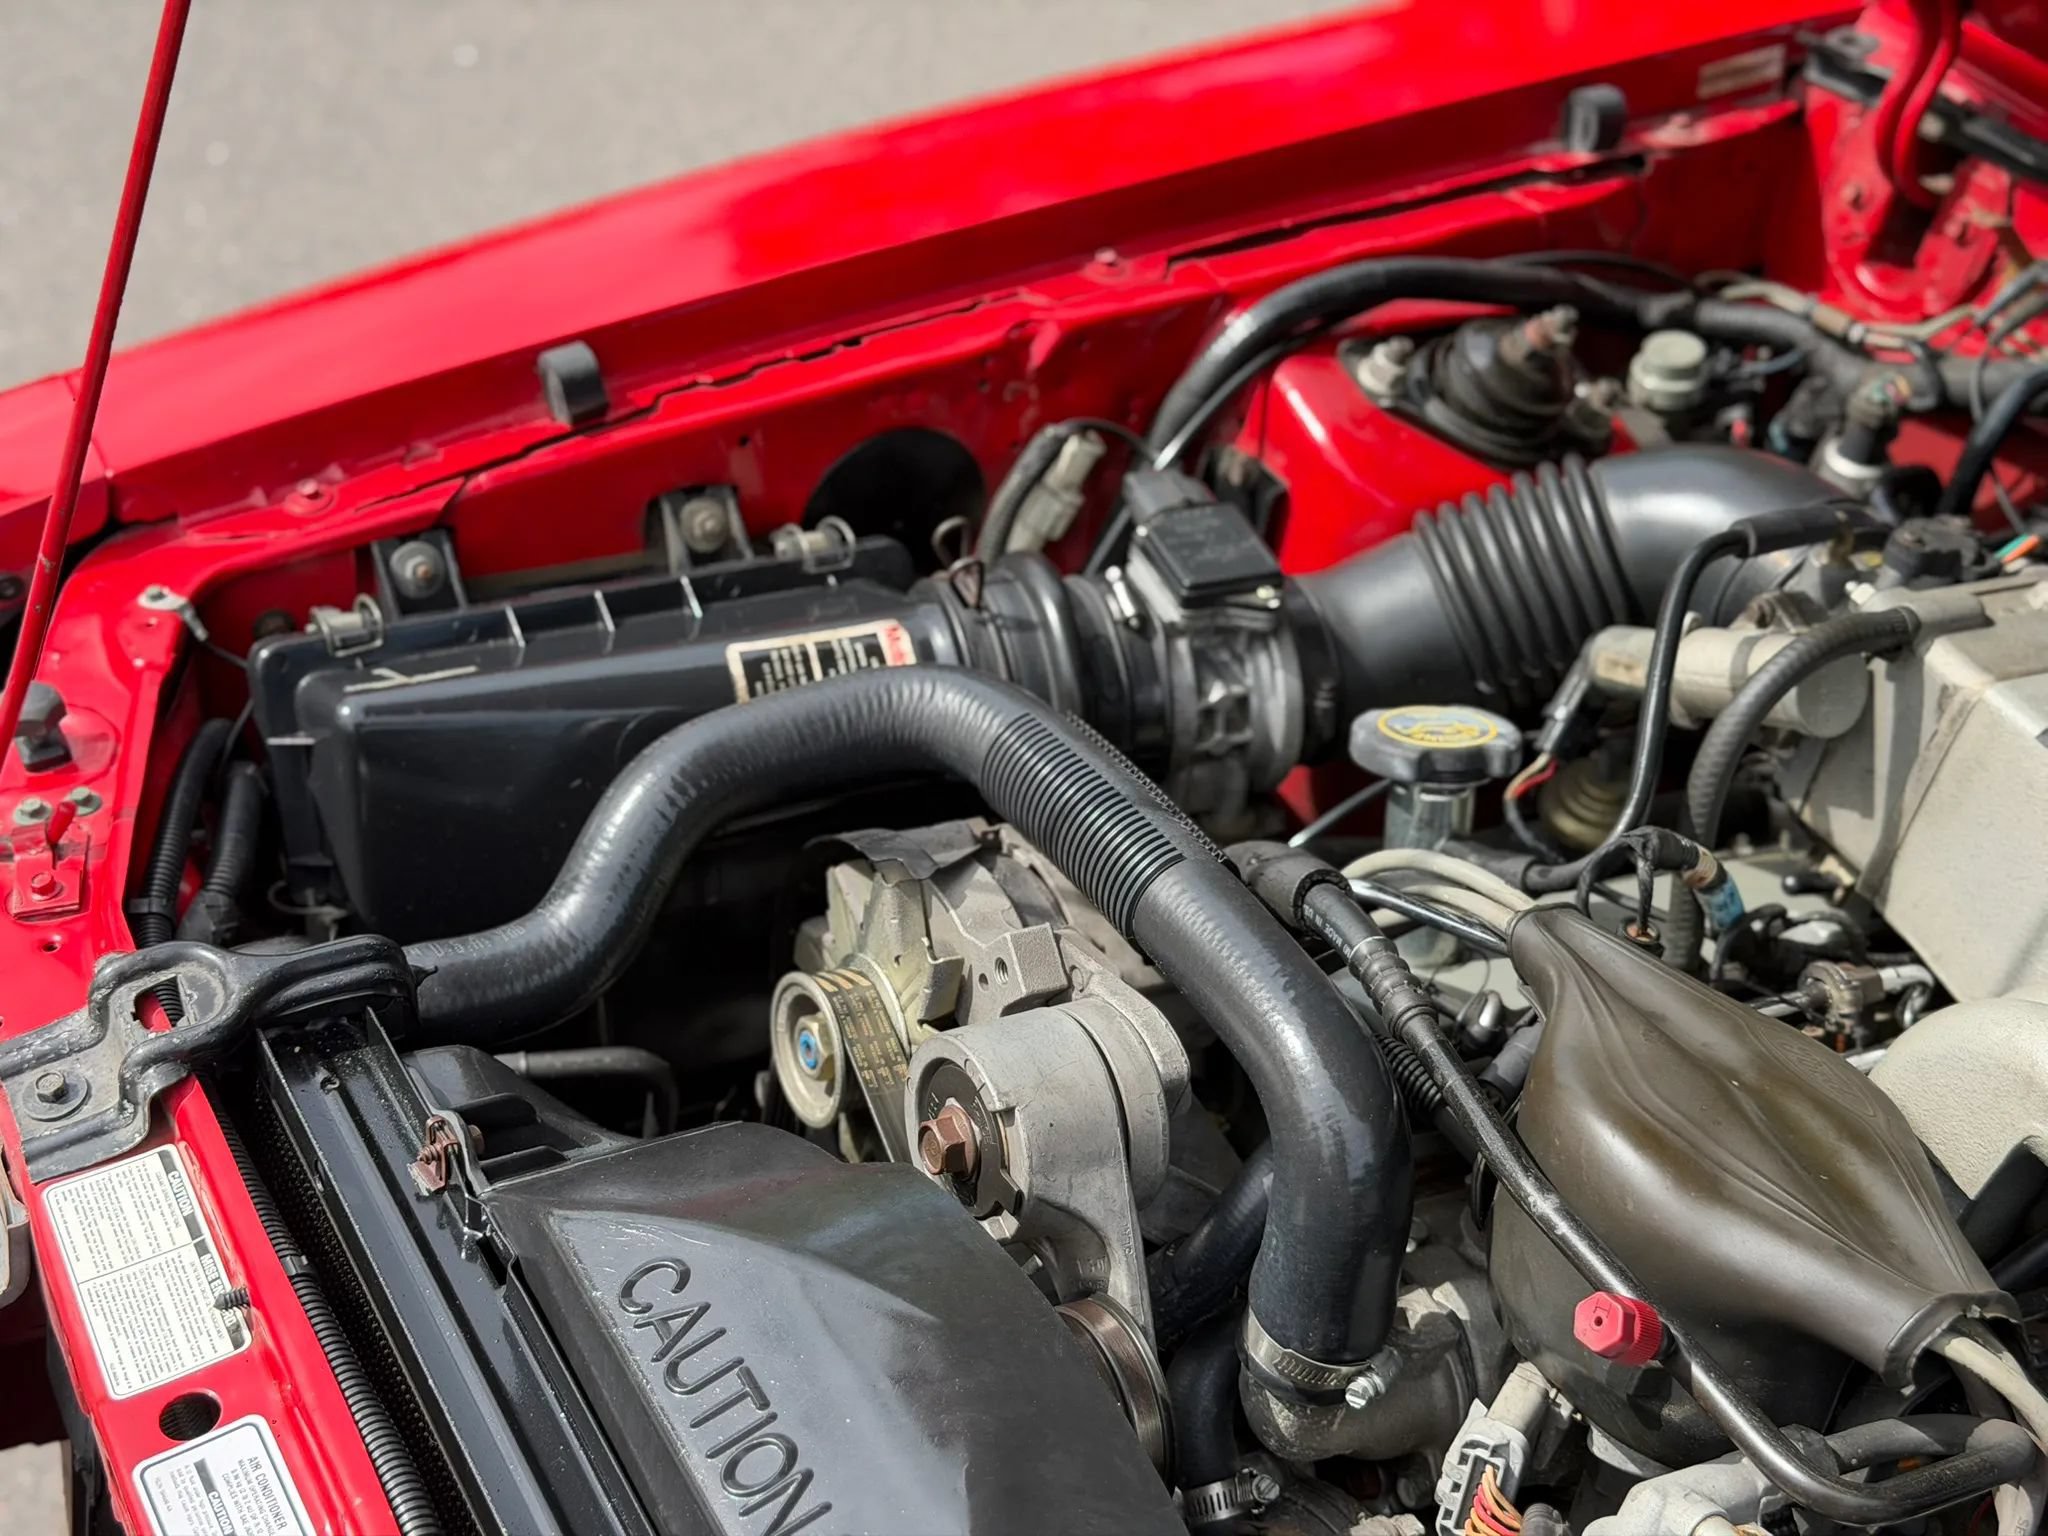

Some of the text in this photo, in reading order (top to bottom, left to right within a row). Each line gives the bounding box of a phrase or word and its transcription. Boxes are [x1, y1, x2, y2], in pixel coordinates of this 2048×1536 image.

[1324, 923, 1343, 947] MADE
[168, 1171, 194, 1216] CAUTION
[200, 1254, 221, 1282] MISE
[617, 1256, 833, 1536] CAUTION
[208, 1490, 234, 1536] CAUTION
[247, 1456, 288, 1530] AIR CONDITIONER
[248, 1485, 266, 1515] OPERATING
